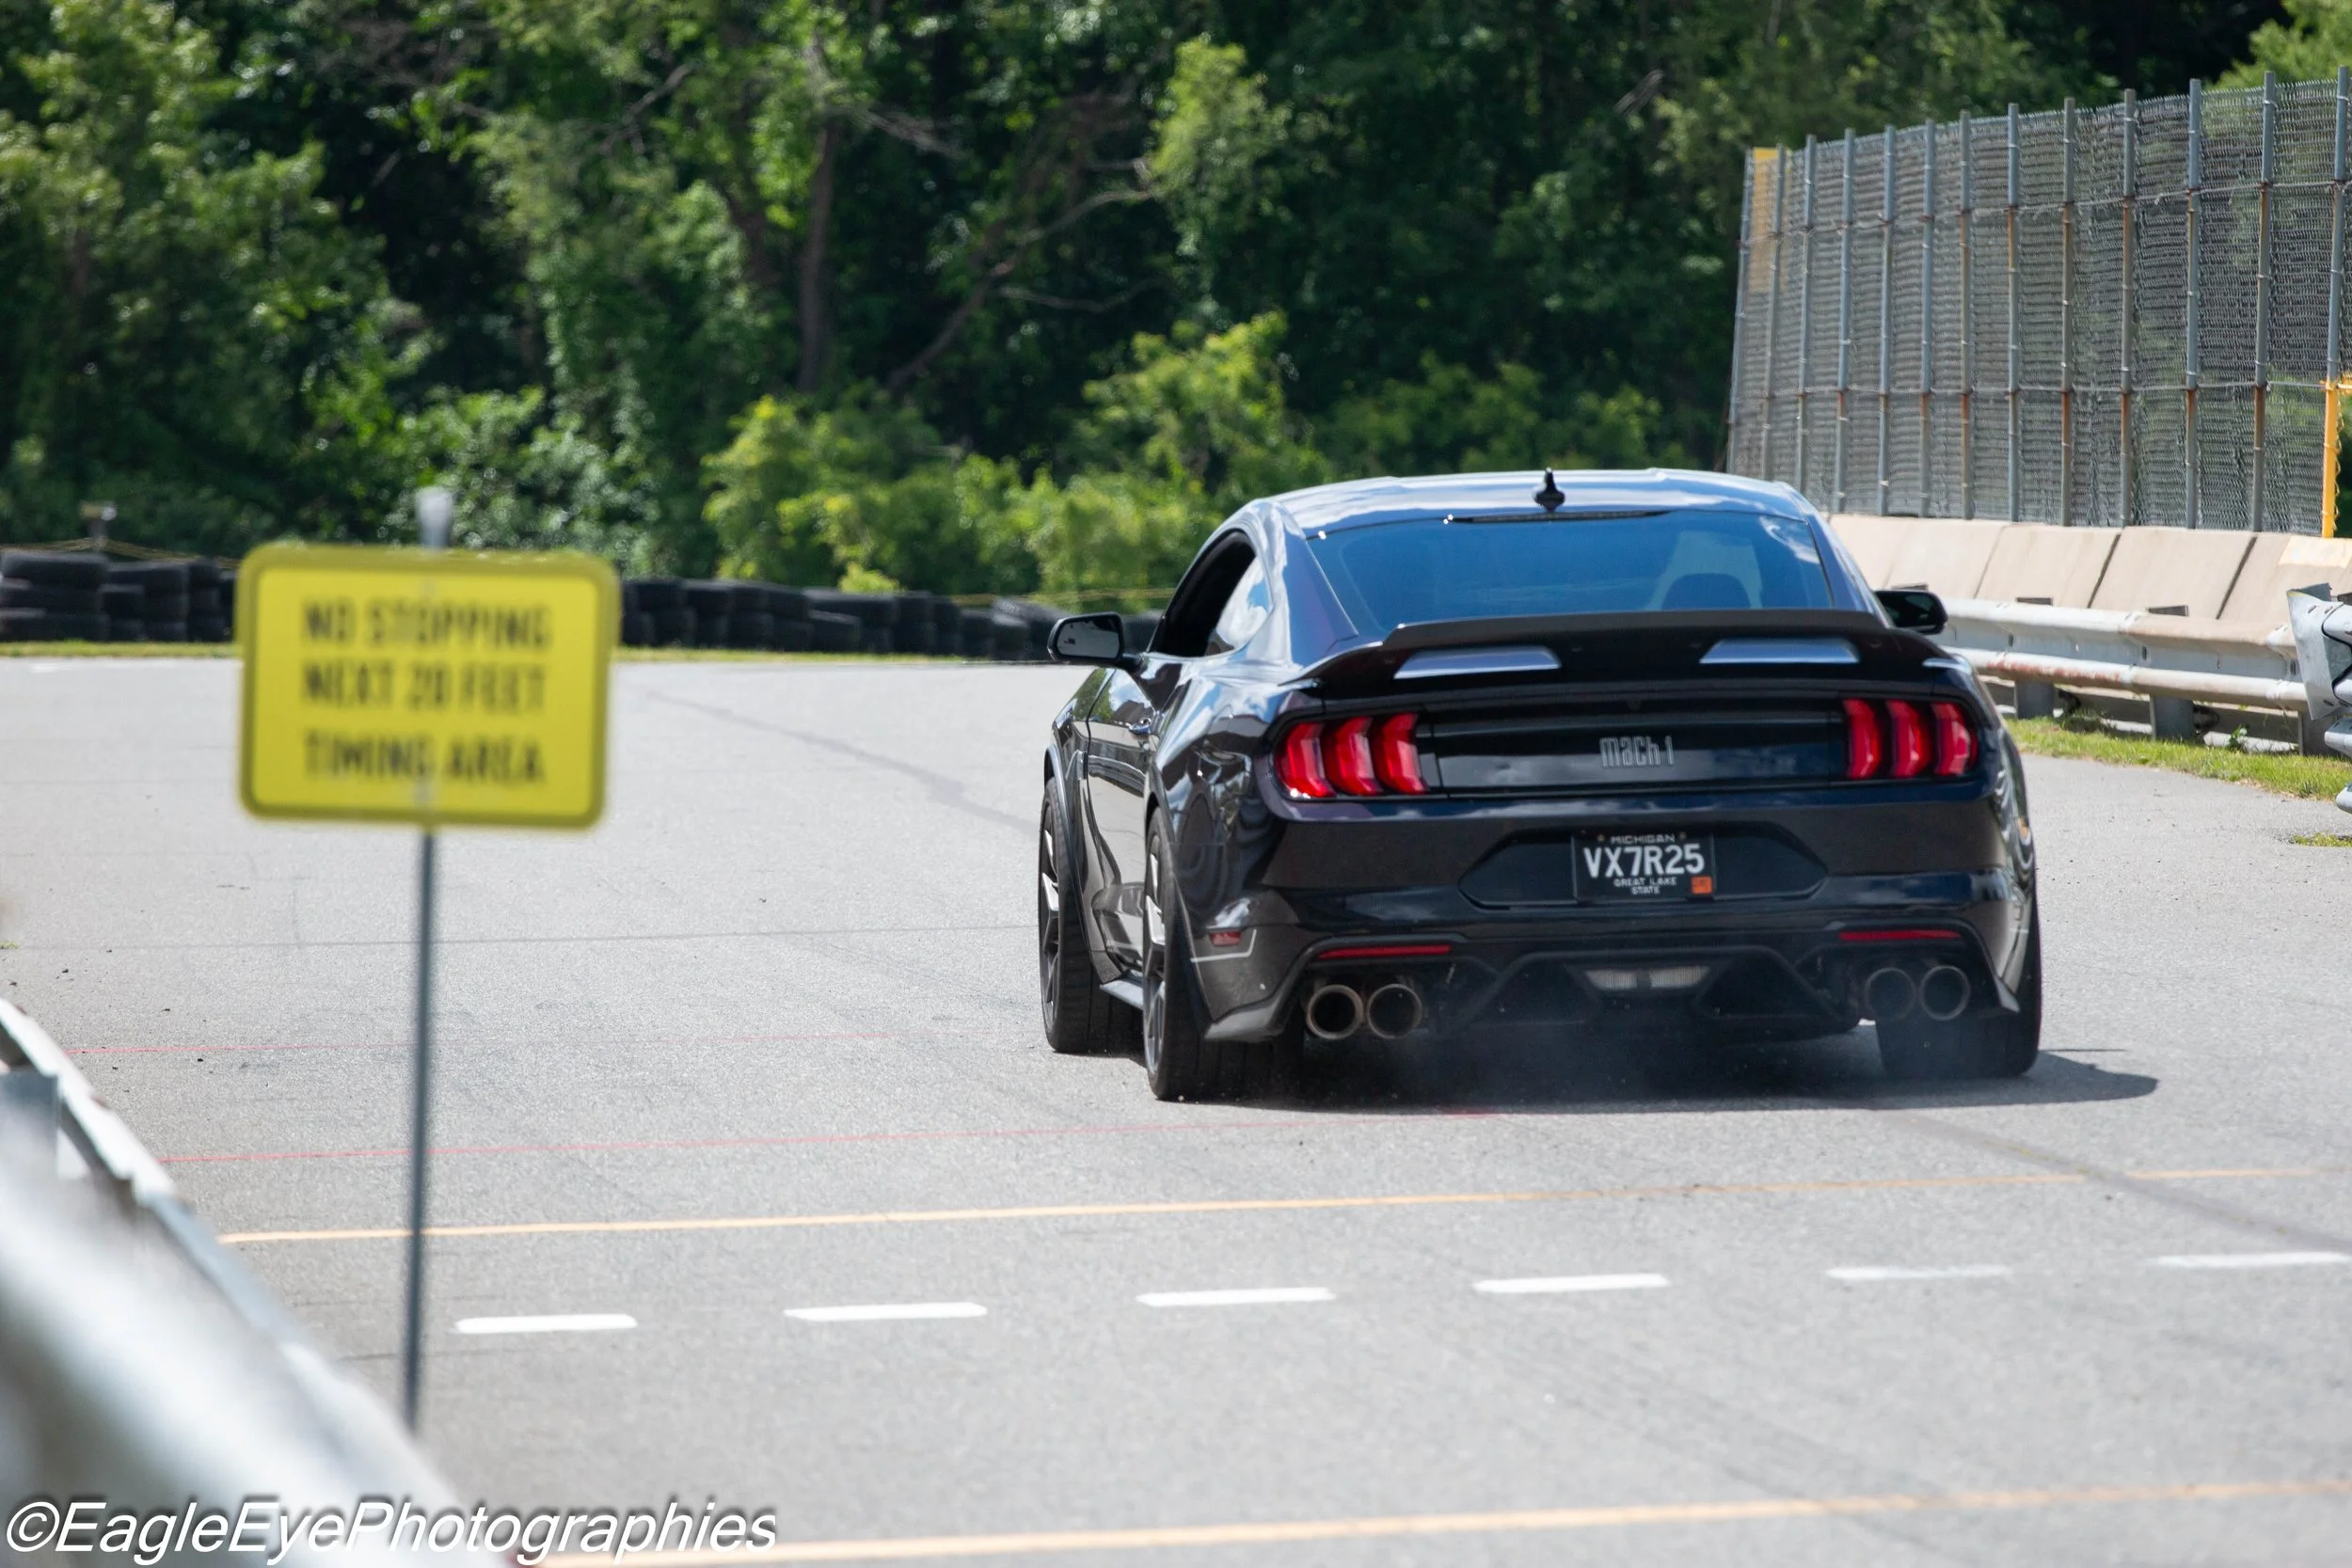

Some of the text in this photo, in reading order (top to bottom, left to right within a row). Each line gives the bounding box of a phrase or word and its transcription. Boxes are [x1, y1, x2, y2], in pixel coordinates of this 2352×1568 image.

[303, 598, 553, 650] NO STOPPING
[302, 661, 394, 709] NEXT
[461, 664, 547, 715] FEET
[303, 729, 545, 784] TIMING AREA
[1610, 833, 1676, 845] MICHIGAN
[1583, 844, 1705, 879] VX7R25
[1613, 877, 1677, 887] GREAT LAKE
[1631, 886, 1661, 895] STATE
